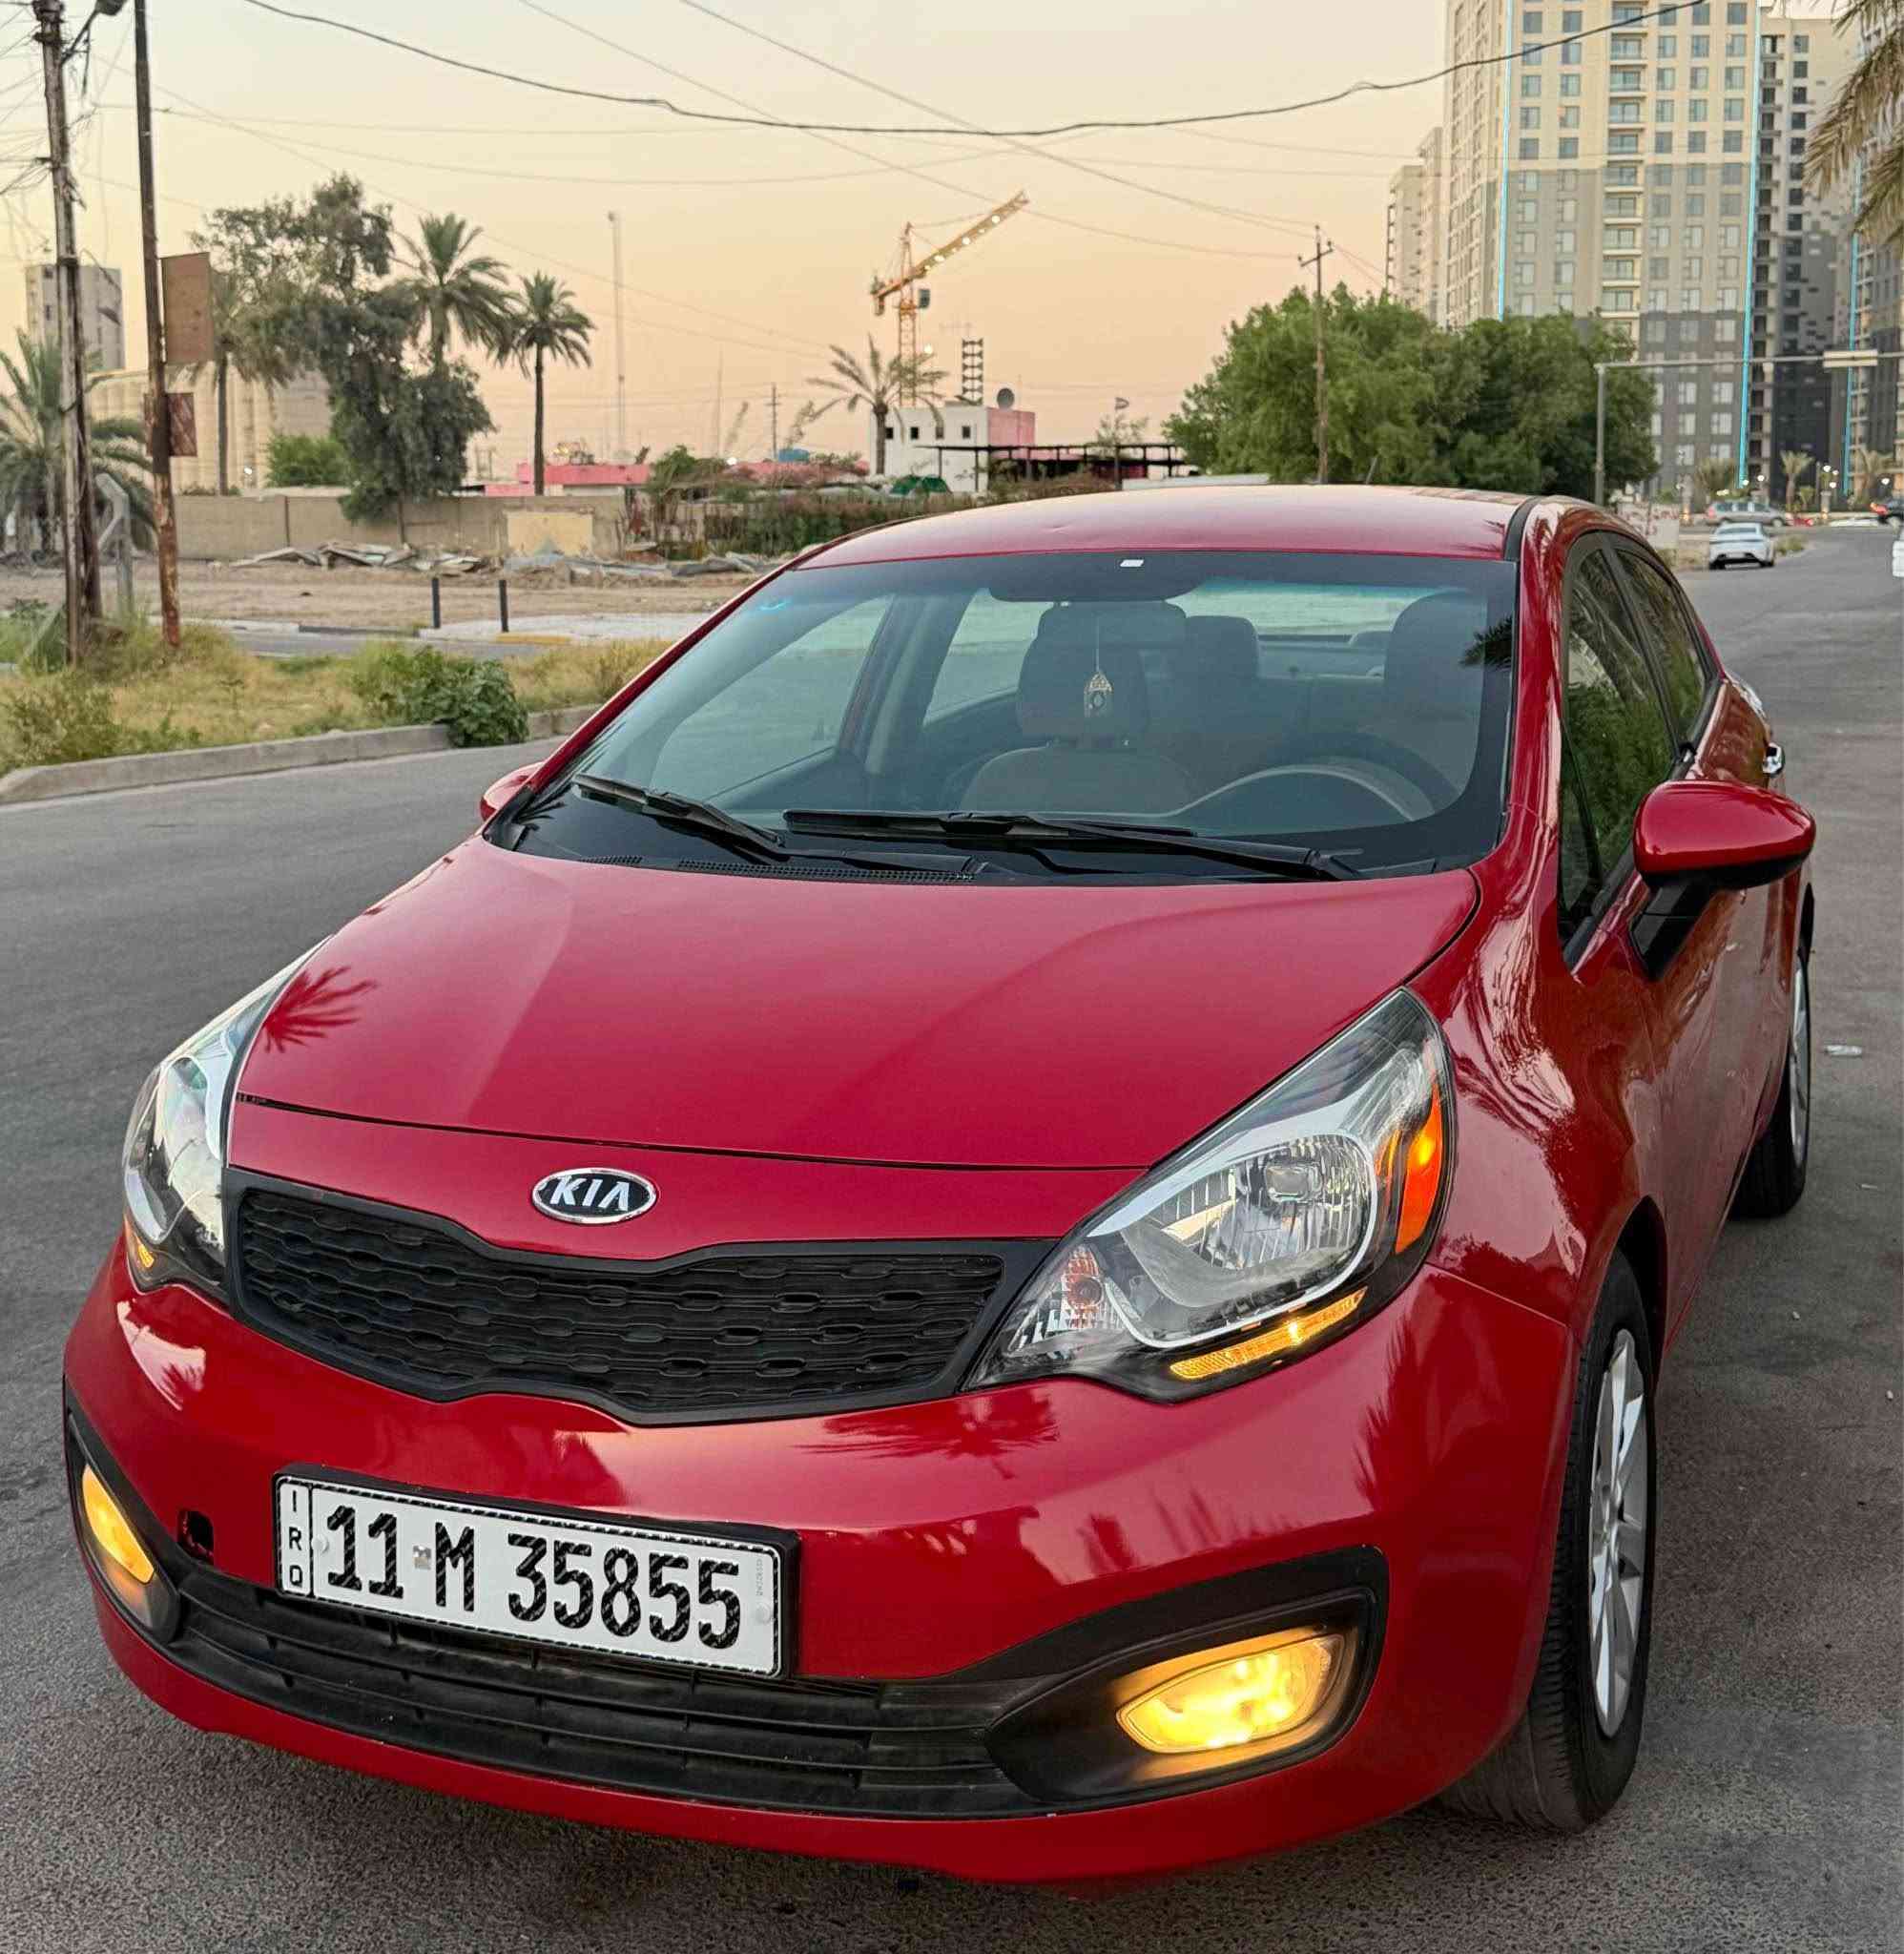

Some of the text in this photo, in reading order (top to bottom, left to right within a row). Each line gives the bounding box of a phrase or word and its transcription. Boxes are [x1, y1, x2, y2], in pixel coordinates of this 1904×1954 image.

[549, 1174, 631, 1212] KIA
[288, 1489, 303, 1589] IRQ
[326, 1505, 404, 1599] 11
[435, 1521, 475, 1612] M
[507, 1532, 741, 1650] 35855
